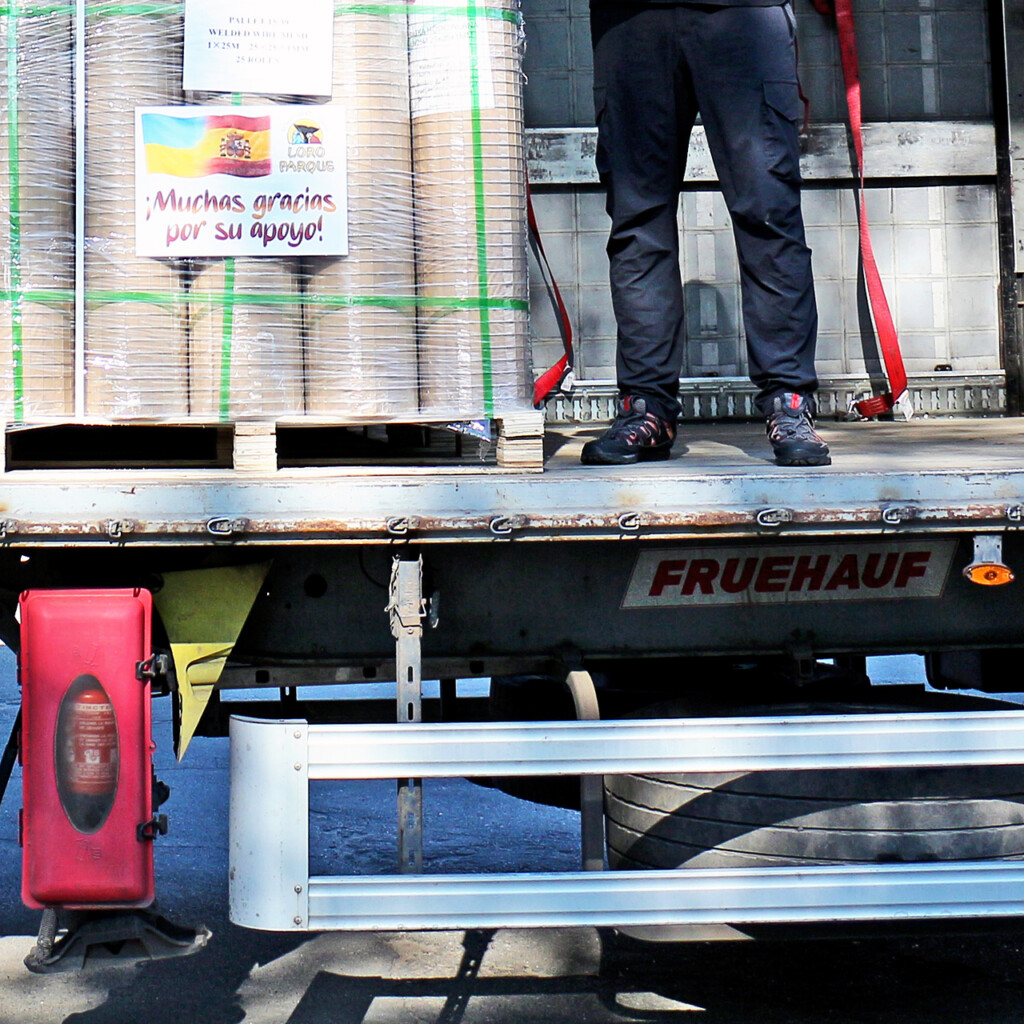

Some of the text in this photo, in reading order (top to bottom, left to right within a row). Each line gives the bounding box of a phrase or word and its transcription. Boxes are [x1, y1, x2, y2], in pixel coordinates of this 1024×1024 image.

[229, 16, 264, 25] PALLET
[208, 28, 309, 40] WELDED WIRE MESH
[236, 55, 280, 65] 25 ROLLS
[287, 147, 326, 158] LORO
[279, 160, 334, 173] PARQUE
[146, 187, 336, 221] ¡Muchas gracias
[166, 214, 323, 247] por su apoyo!
[648, 551, 932, 597] FRUEHAUF
